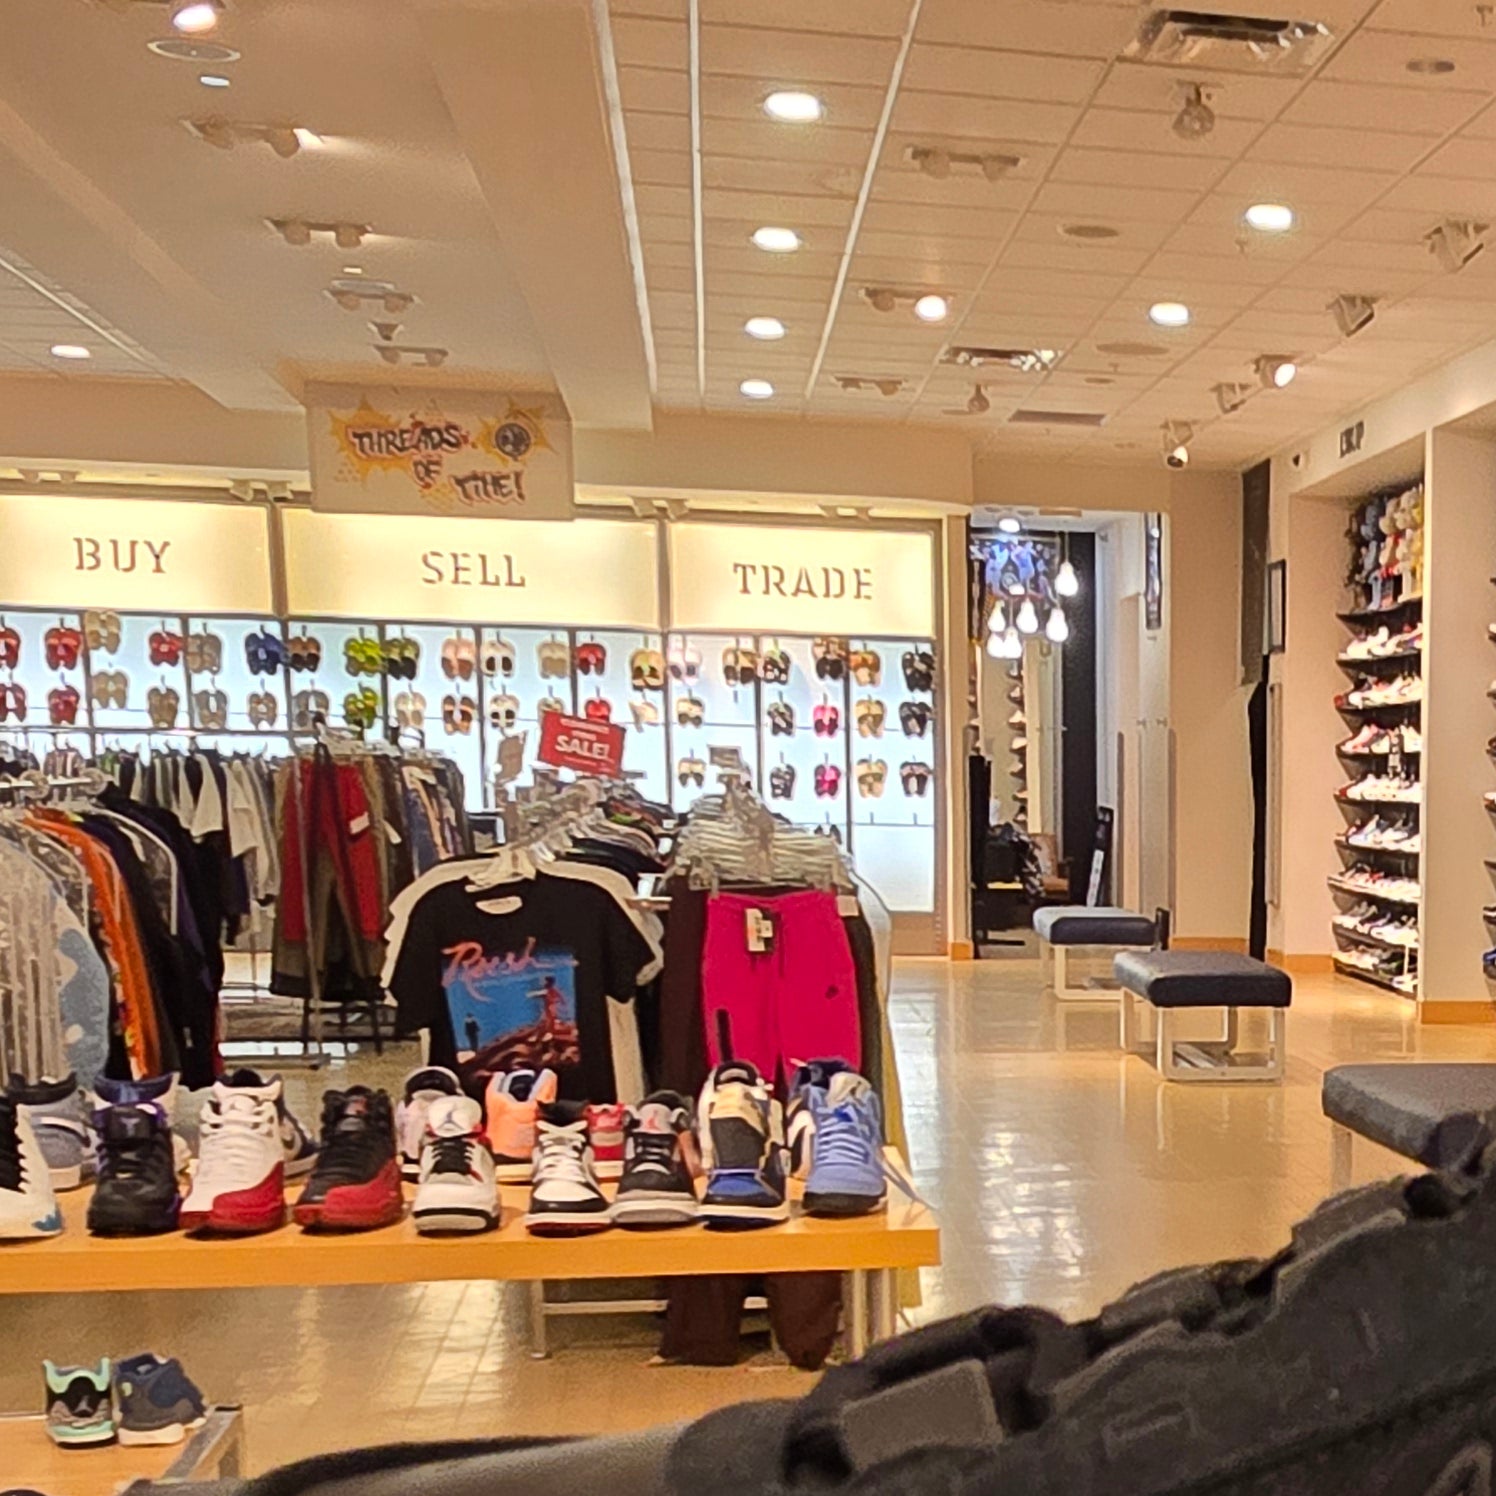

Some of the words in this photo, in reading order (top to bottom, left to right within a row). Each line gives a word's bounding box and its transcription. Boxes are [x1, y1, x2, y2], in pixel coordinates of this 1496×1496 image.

[351, 425, 464, 455] THREADS
[412, 457, 443, 483] OF
[73, 537, 171, 574] BUY
[422, 551, 526, 588] SELL
[733, 562, 872, 600] TRADE
